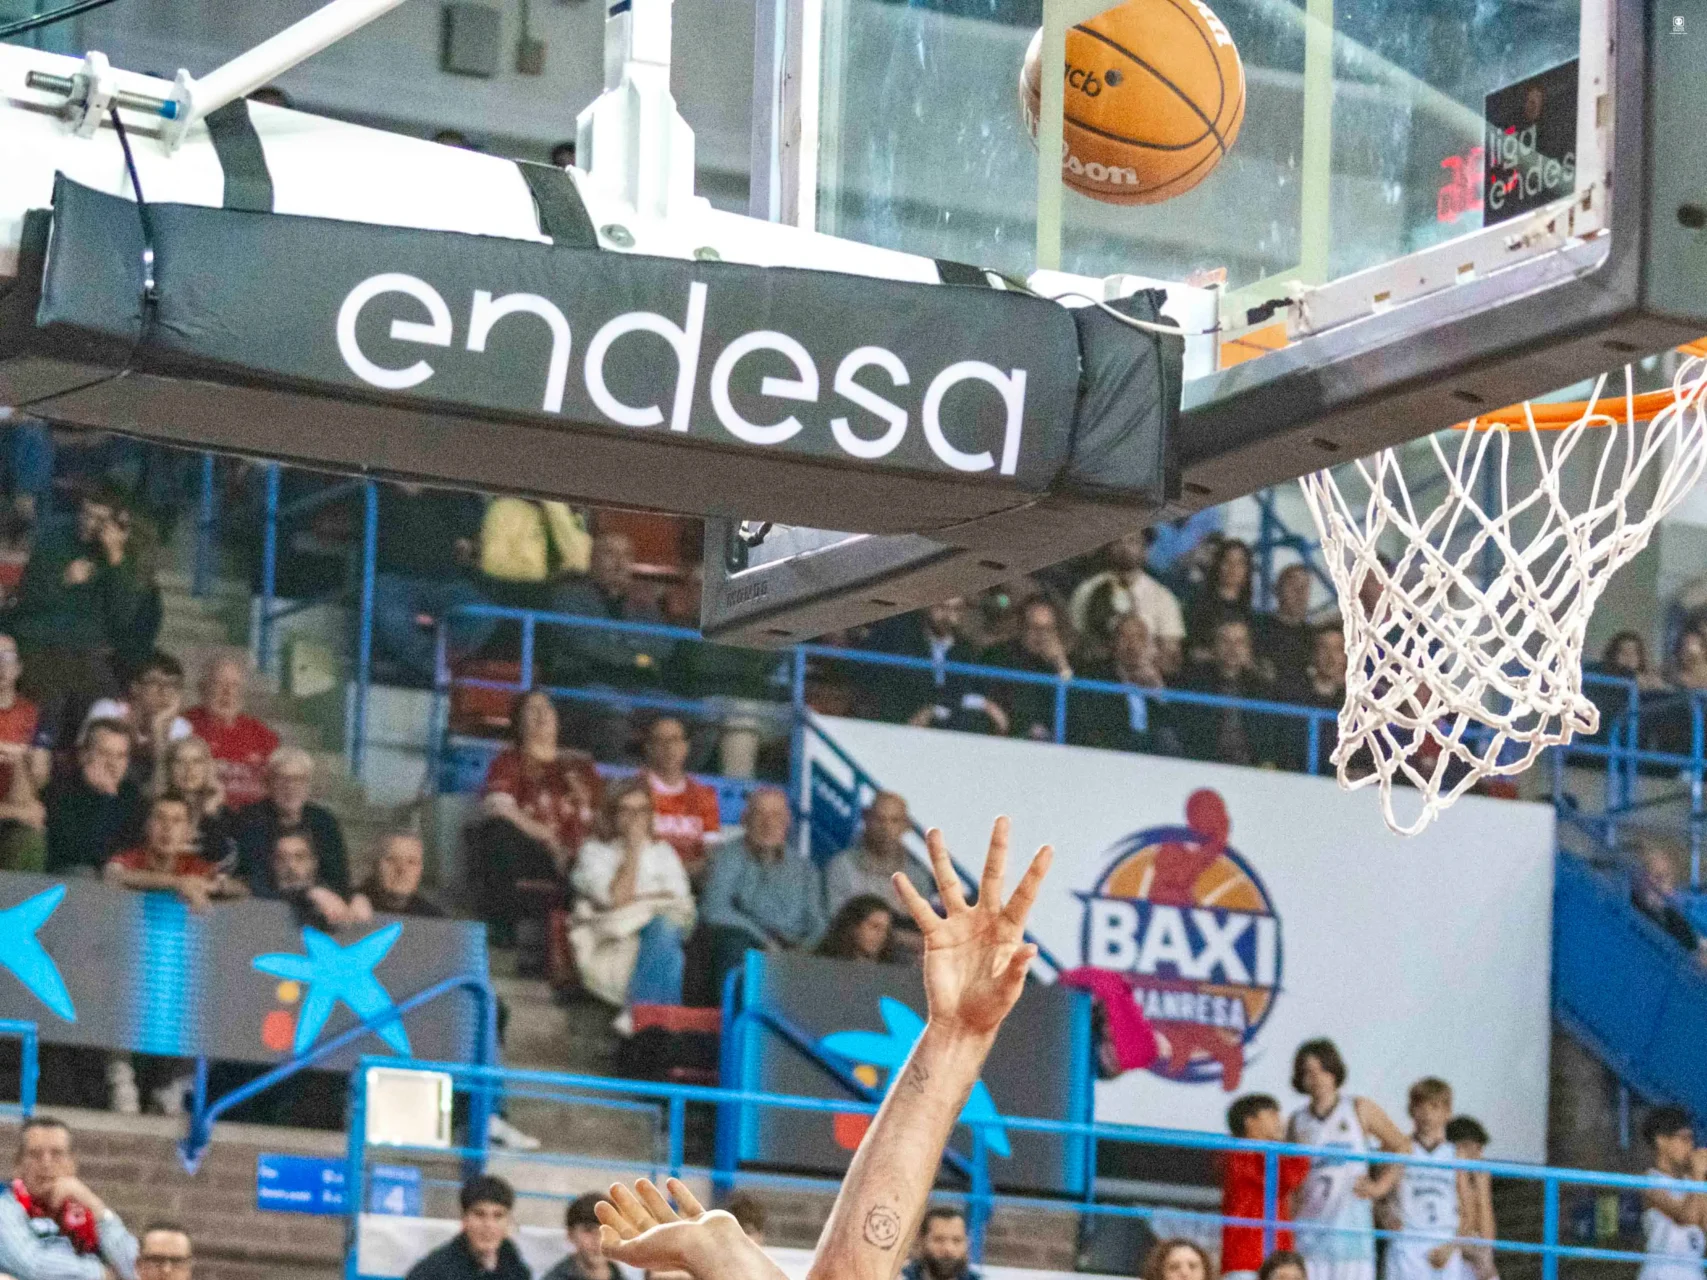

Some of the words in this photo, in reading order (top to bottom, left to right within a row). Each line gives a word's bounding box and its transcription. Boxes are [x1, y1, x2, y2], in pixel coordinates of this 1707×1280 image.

[1489, 124, 1536, 169] liga
[1489, 152, 1575, 210] endes
[336, 272, 1027, 476] endesa
[1090, 900, 1277, 986] BAXI
